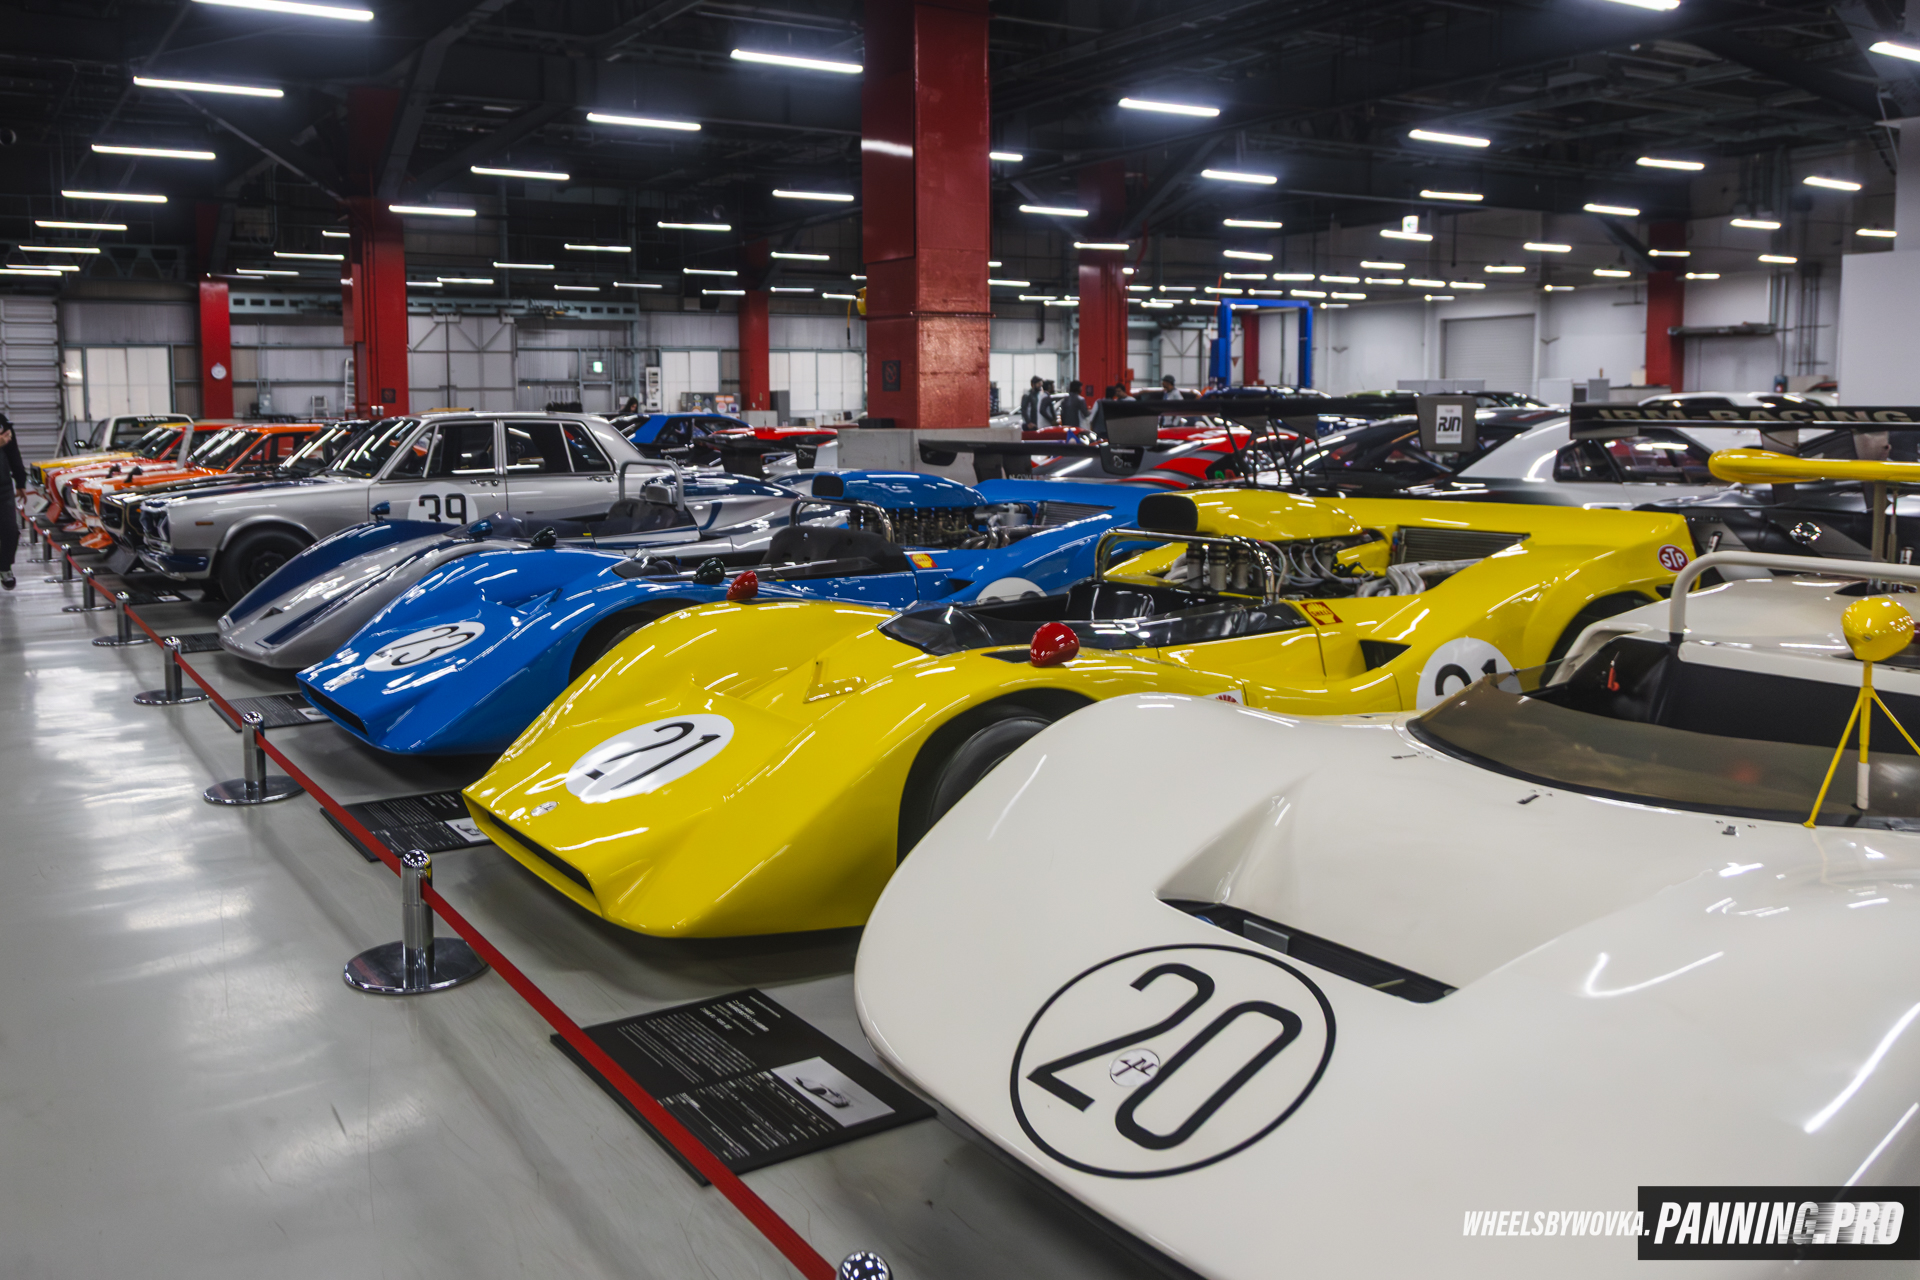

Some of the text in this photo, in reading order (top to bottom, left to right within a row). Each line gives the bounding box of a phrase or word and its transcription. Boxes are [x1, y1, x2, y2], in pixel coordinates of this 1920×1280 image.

[418, 493, 468, 525] 39
[1661, 547, 1686, 569] STP
[374, 625, 476, 667] 23
[576, 721, 722, 791] 21
[1025, 962, 1303, 1151] 20
